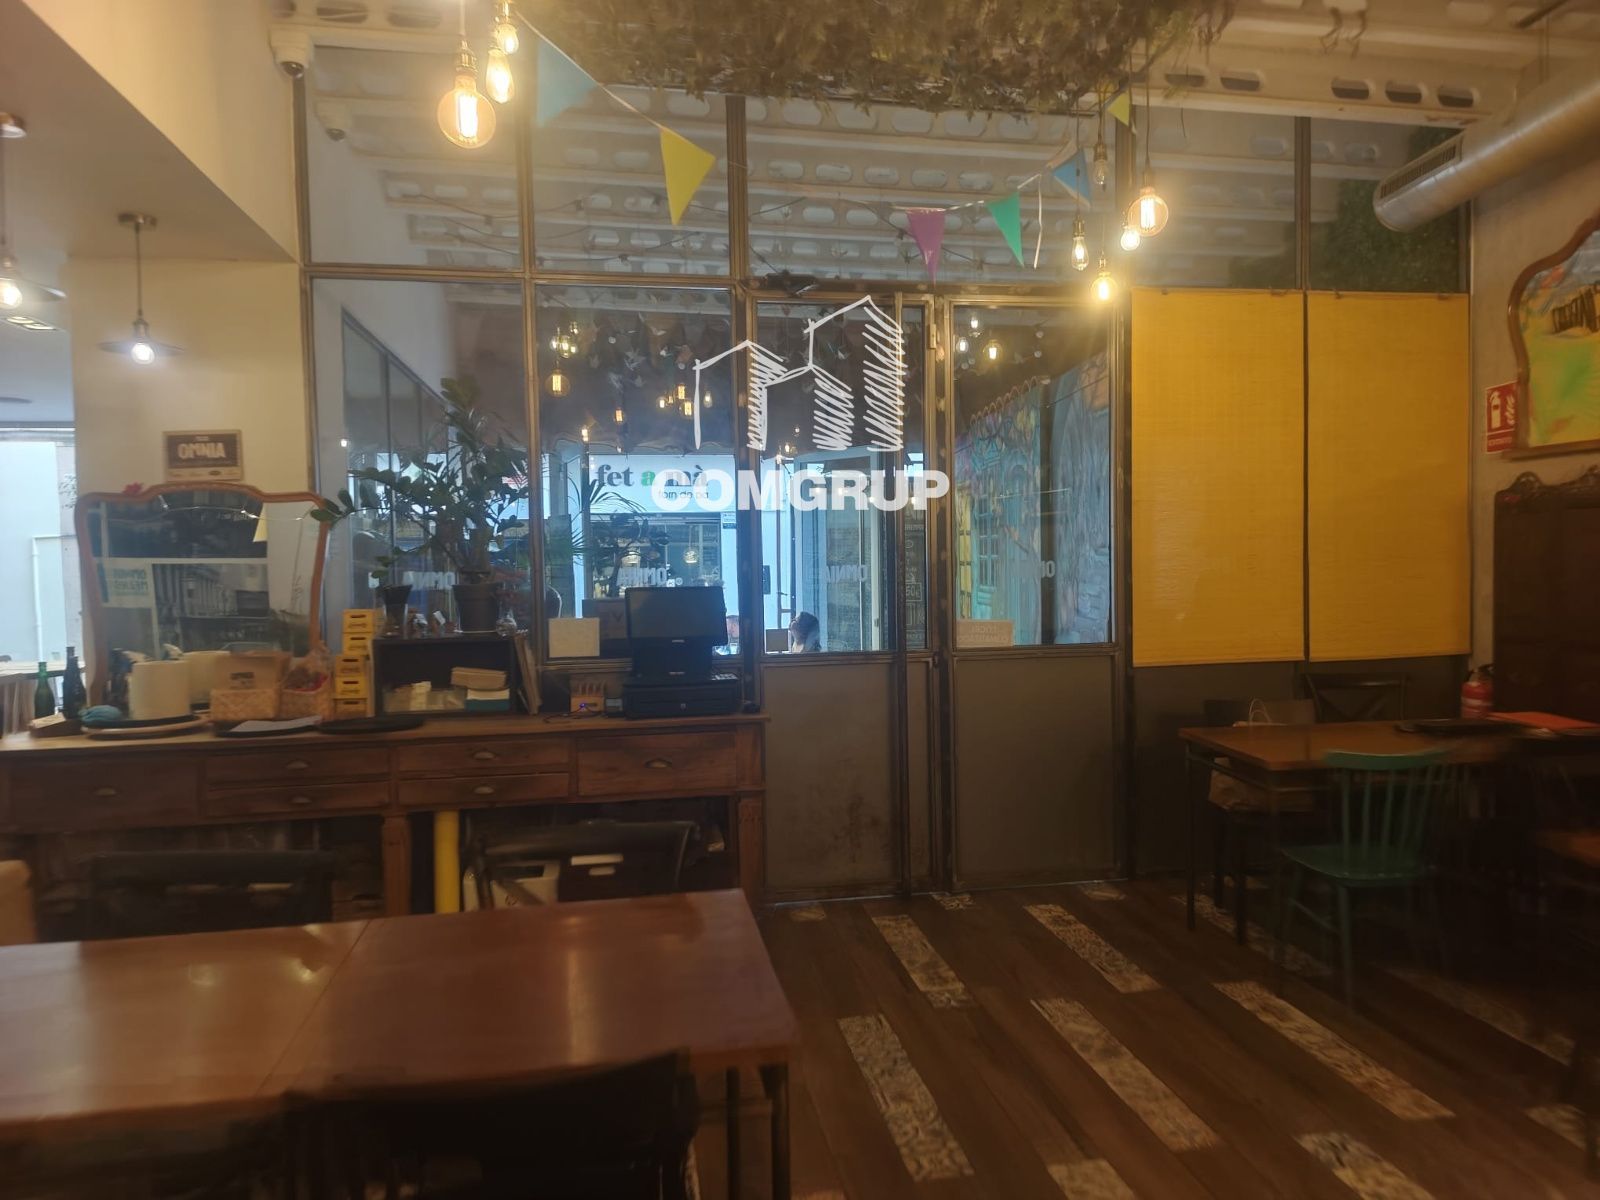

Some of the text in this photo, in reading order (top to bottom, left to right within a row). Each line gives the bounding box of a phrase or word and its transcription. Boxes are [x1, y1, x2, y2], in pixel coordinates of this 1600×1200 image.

[177, 442, 226, 459] OMNIA
[595, 464, 634, 487] fet
[641, 470, 656, 487] a
